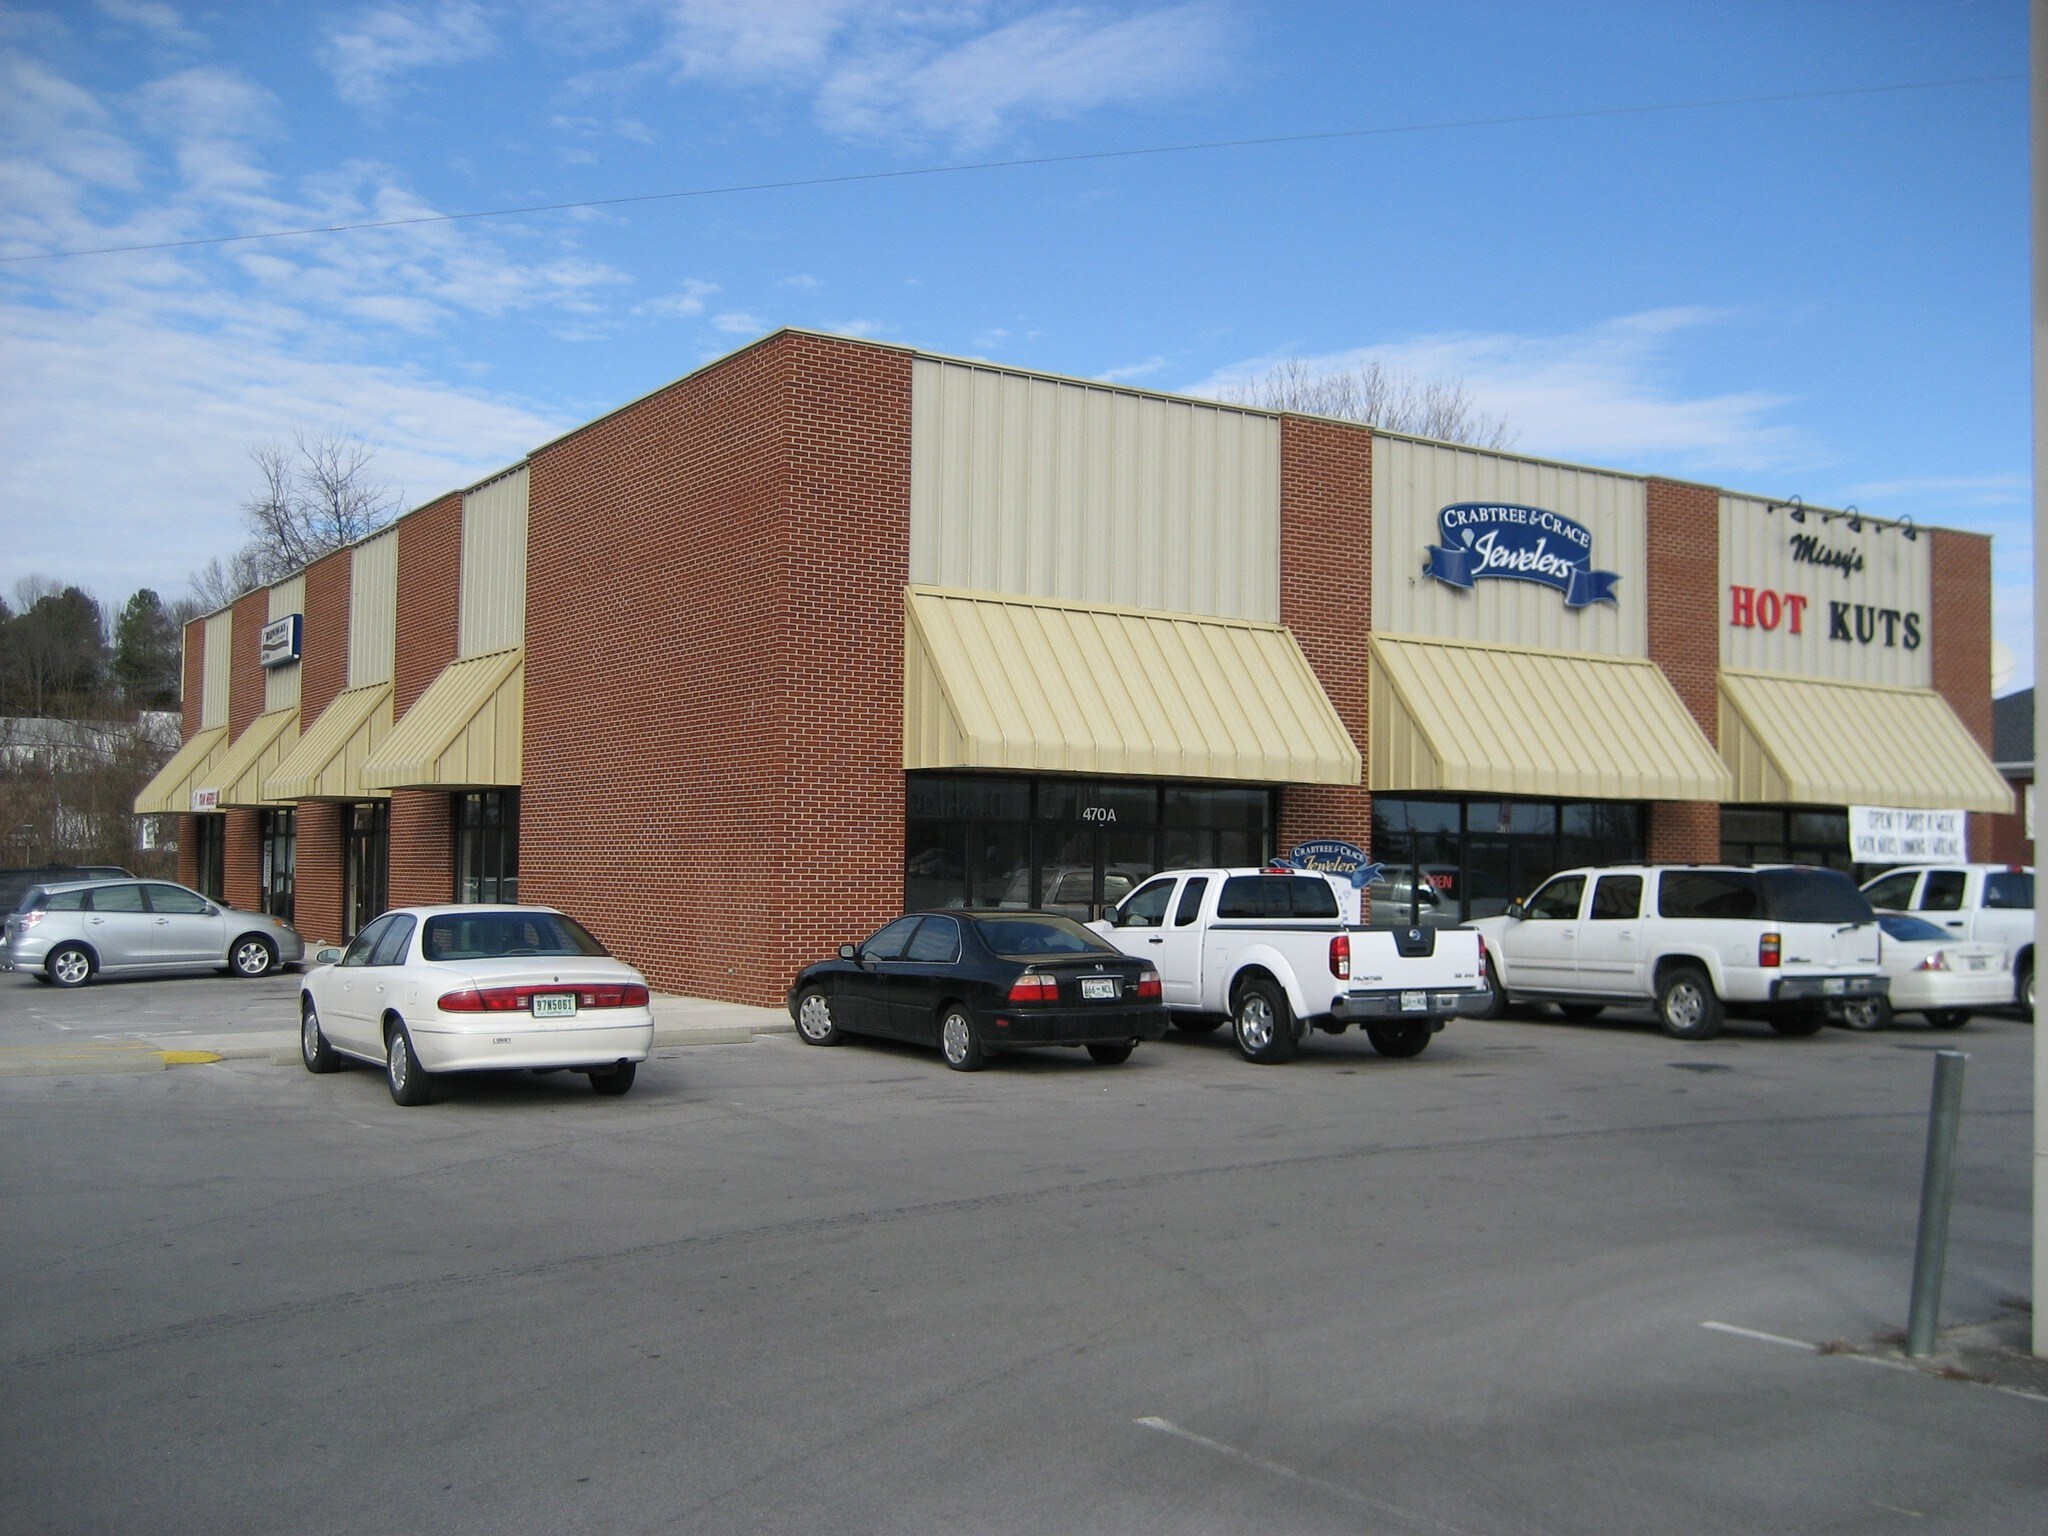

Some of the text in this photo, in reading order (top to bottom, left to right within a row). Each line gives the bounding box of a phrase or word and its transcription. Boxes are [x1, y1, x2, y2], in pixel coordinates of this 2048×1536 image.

[1444, 507, 1590, 548] CRABTREE & CRACE
[1471, 529, 1573, 578] Jewelers
[1789, 533, 1864, 579] Missy's
[1730, 584, 1921, 651] HOT KUTS
[1082, 807, 1117, 821] 470A
[1294, 845, 1333, 857] CRABTREE
[1340, 846, 1365, 862] CRACE
[1303, 854, 1358, 873] Jewelers
[1424, 875, 1453, 889] OPEN
[536, 1000, 572, 1011] 97N5061
